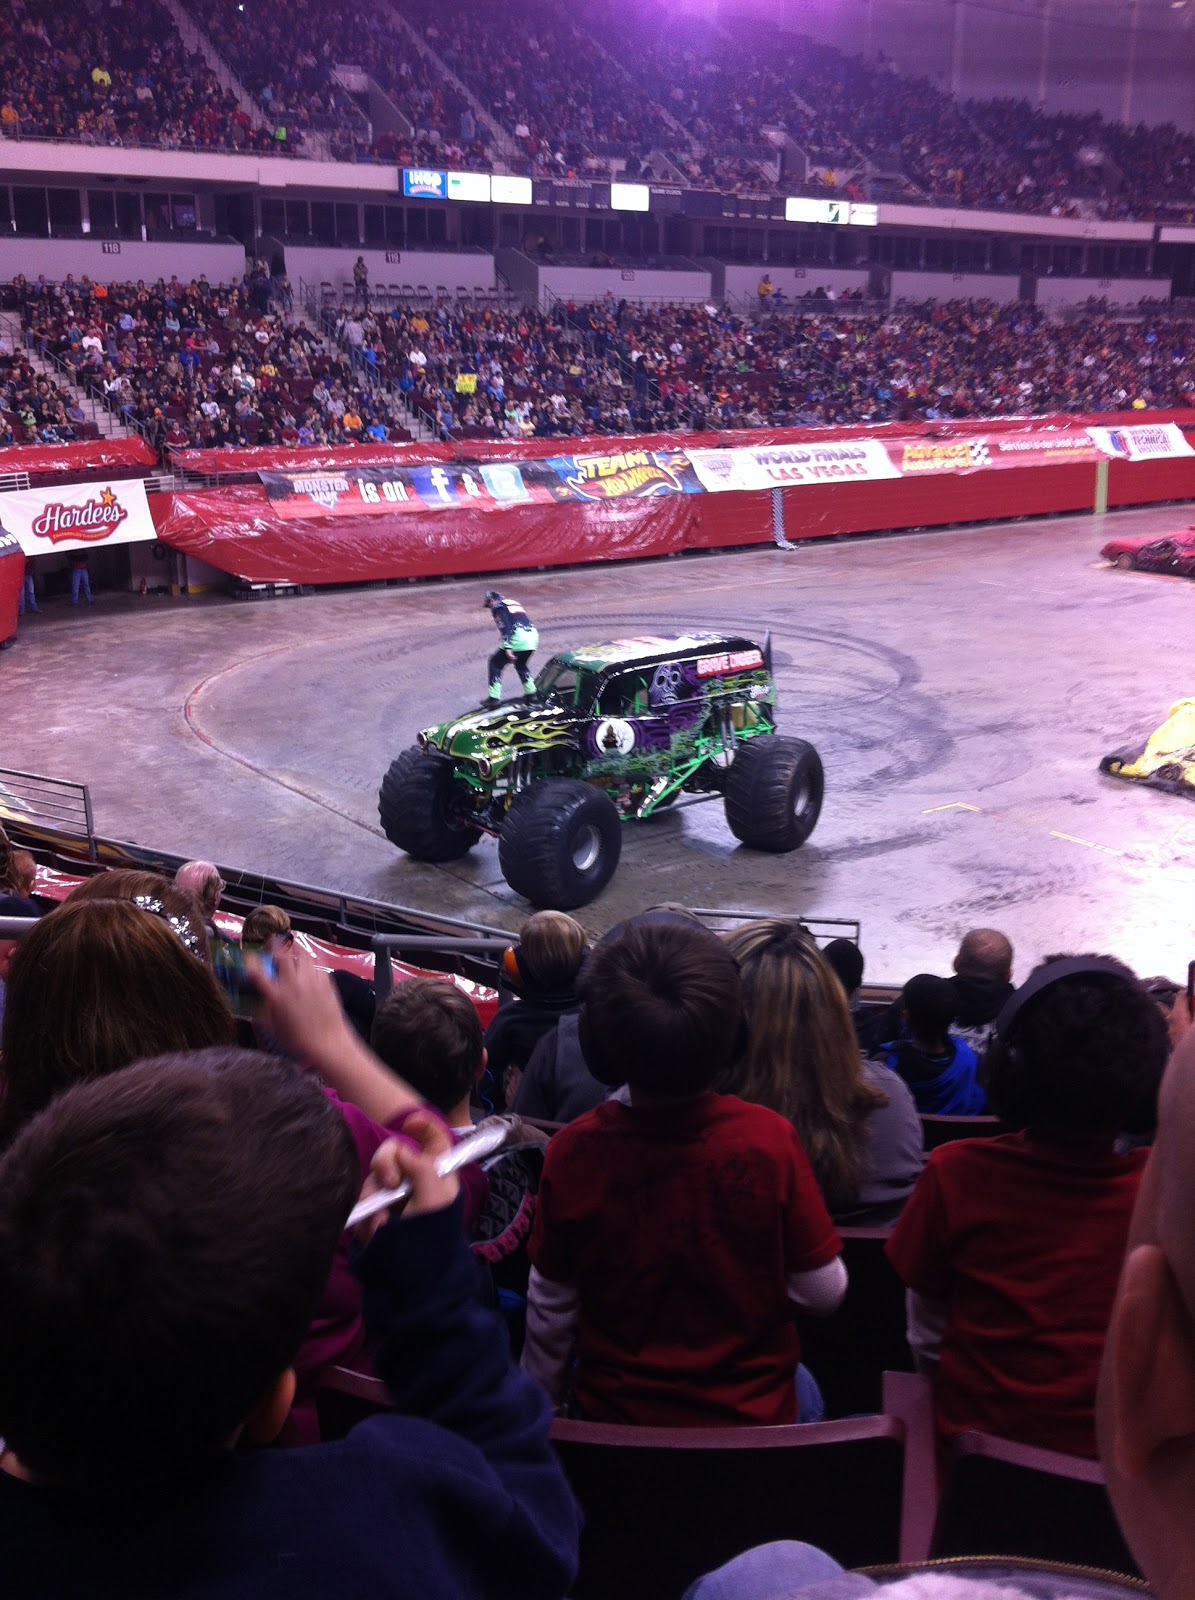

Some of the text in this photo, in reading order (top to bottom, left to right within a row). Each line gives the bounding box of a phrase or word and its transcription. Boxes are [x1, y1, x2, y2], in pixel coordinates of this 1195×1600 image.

[103, 243, 119, 253] 118
[578, 452, 649, 478] TEAM
[752, 450, 811, 466] WORLD
[814, 448, 867, 463] FINALS
[767, 463, 868, 481] LAS VEGAS
[293, 478, 350, 494] MONSTER
[358, 478, 381, 503] is
[383, 480, 409, 502] on
